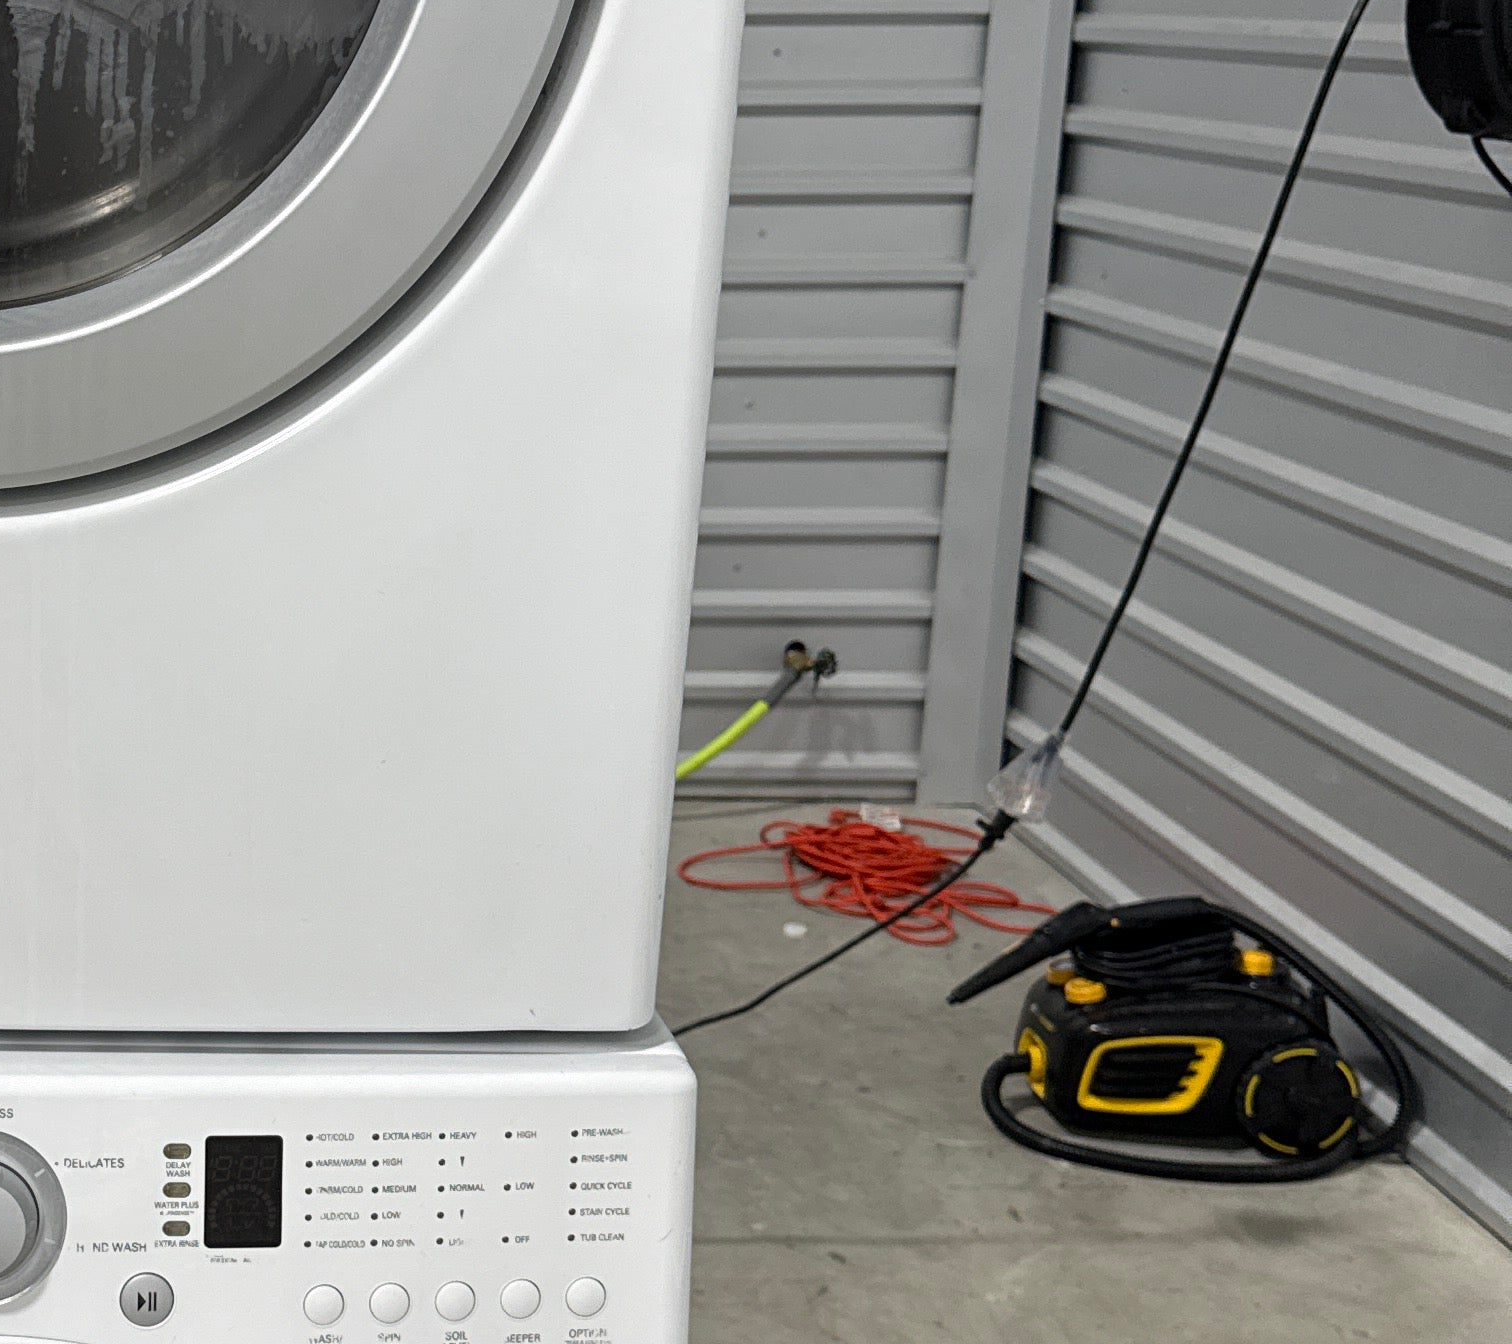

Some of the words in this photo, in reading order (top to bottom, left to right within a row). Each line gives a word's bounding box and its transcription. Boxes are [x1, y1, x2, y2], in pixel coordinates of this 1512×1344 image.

[382, 1132, 409, 1140] EXTRA
[411, 1131, 432, 1140] HIGH
[449, 1131, 477, 1140] HEAVY
[516, 1130, 537, 1139] HIGH
[165, 1161, 192, 1169] DELAY
[382, 1158, 403, 1166] HIGH
[317, 1186, 364, 1194] ARM/COLD
[381, 1184, 417, 1193] MEDIUM
[449, 1183, 485, 1192] NORMAL
[515, 1182, 534, 1190] LOW
[580, 1182, 605, 1191] QUICK
[606, 1181, 632, 1190] CYCLE
[154, 1201, 179, 1209] WATER
[181, 1201, 199, 1209] PLUS
[381, 1211, 402, 1219] LOW
[579, 1208, 603, 1216] STAIN
[605, 1207, 630, 1216] CYCLE
[514, 1235, 530, 1244] OFF
[580, 1233, 597, 1242] TUB
[598, 1233, 625, 1242] CLEAN
[76, 1242, 109, 1253] HND
[112, 1242, 147, 1253] WASH
[381, 1239, 394, 1247] NO
[444, 1330, 468, 1341] SOIL
